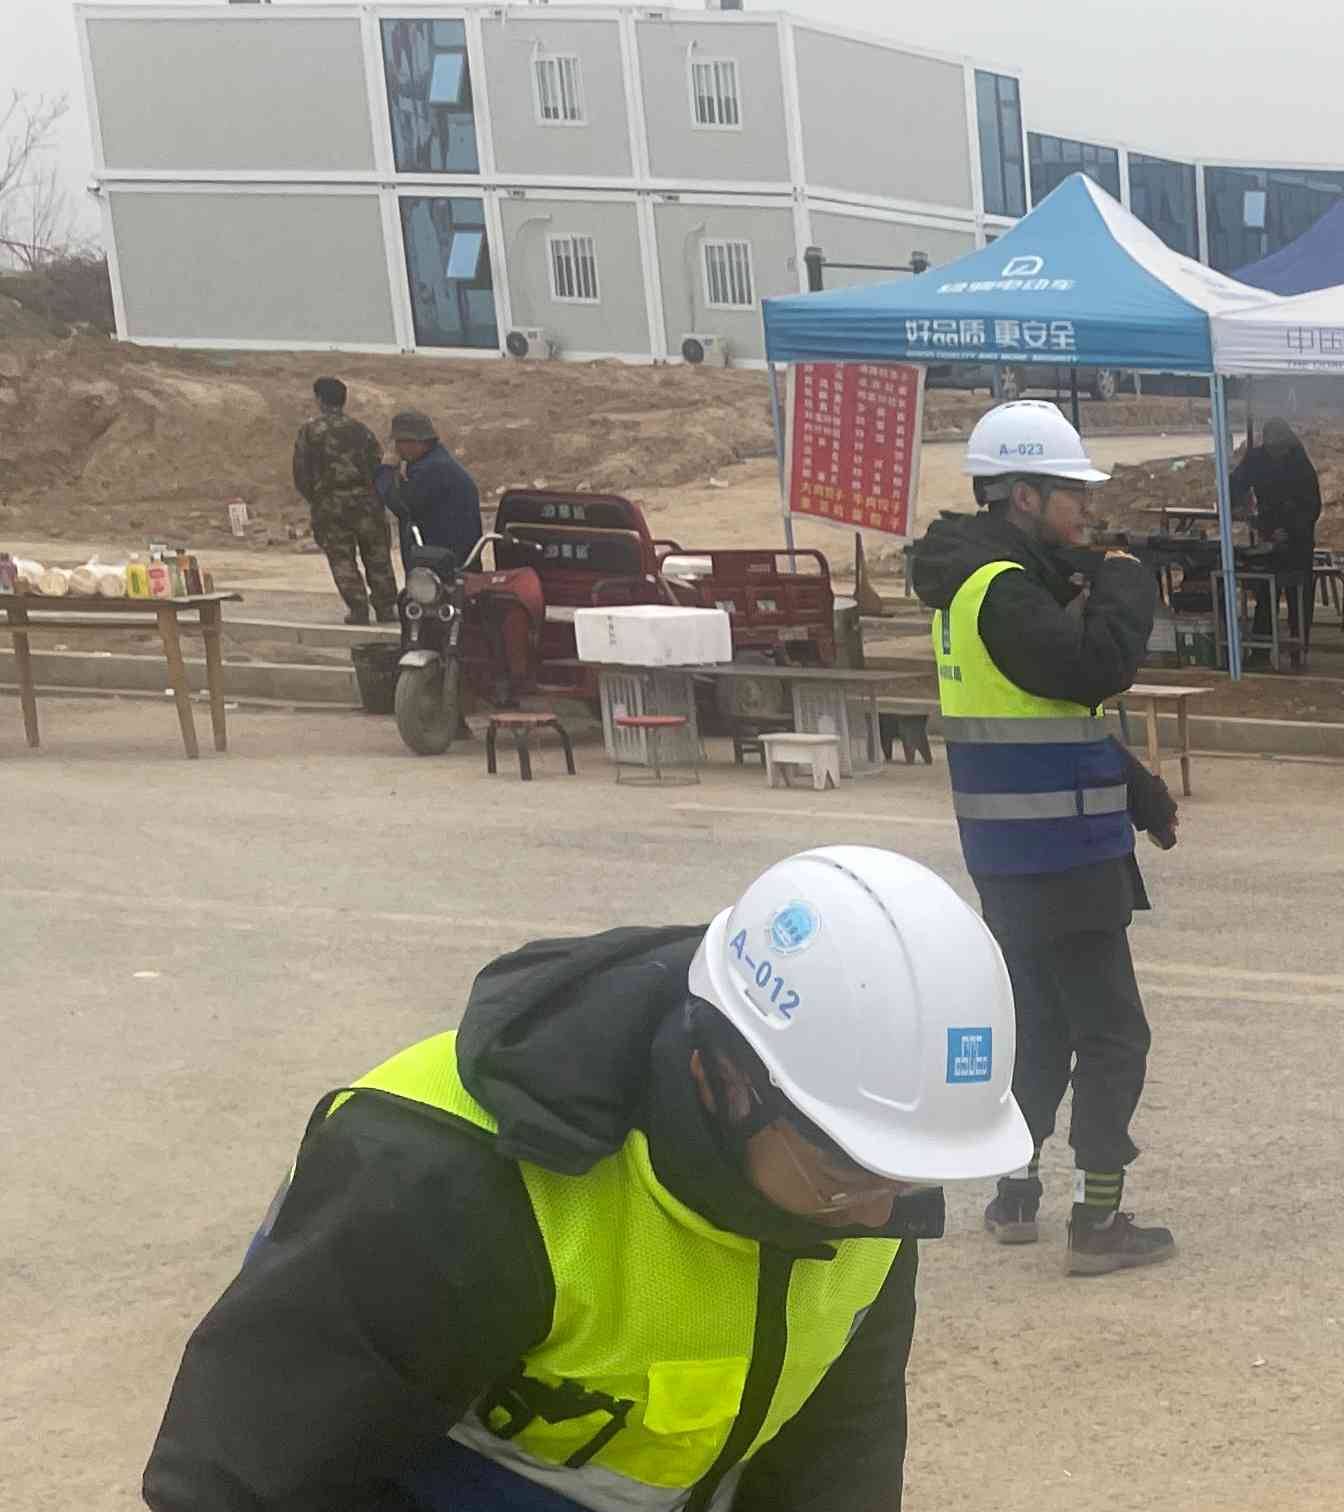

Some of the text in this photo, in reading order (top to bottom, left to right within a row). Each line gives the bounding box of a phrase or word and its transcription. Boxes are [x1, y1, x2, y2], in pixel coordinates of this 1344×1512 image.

[905, 319, 1076, 351] 好品质 更安全
[999, 443, 1044, 456] A-023
[729, 928, 801, 1021] A-012
